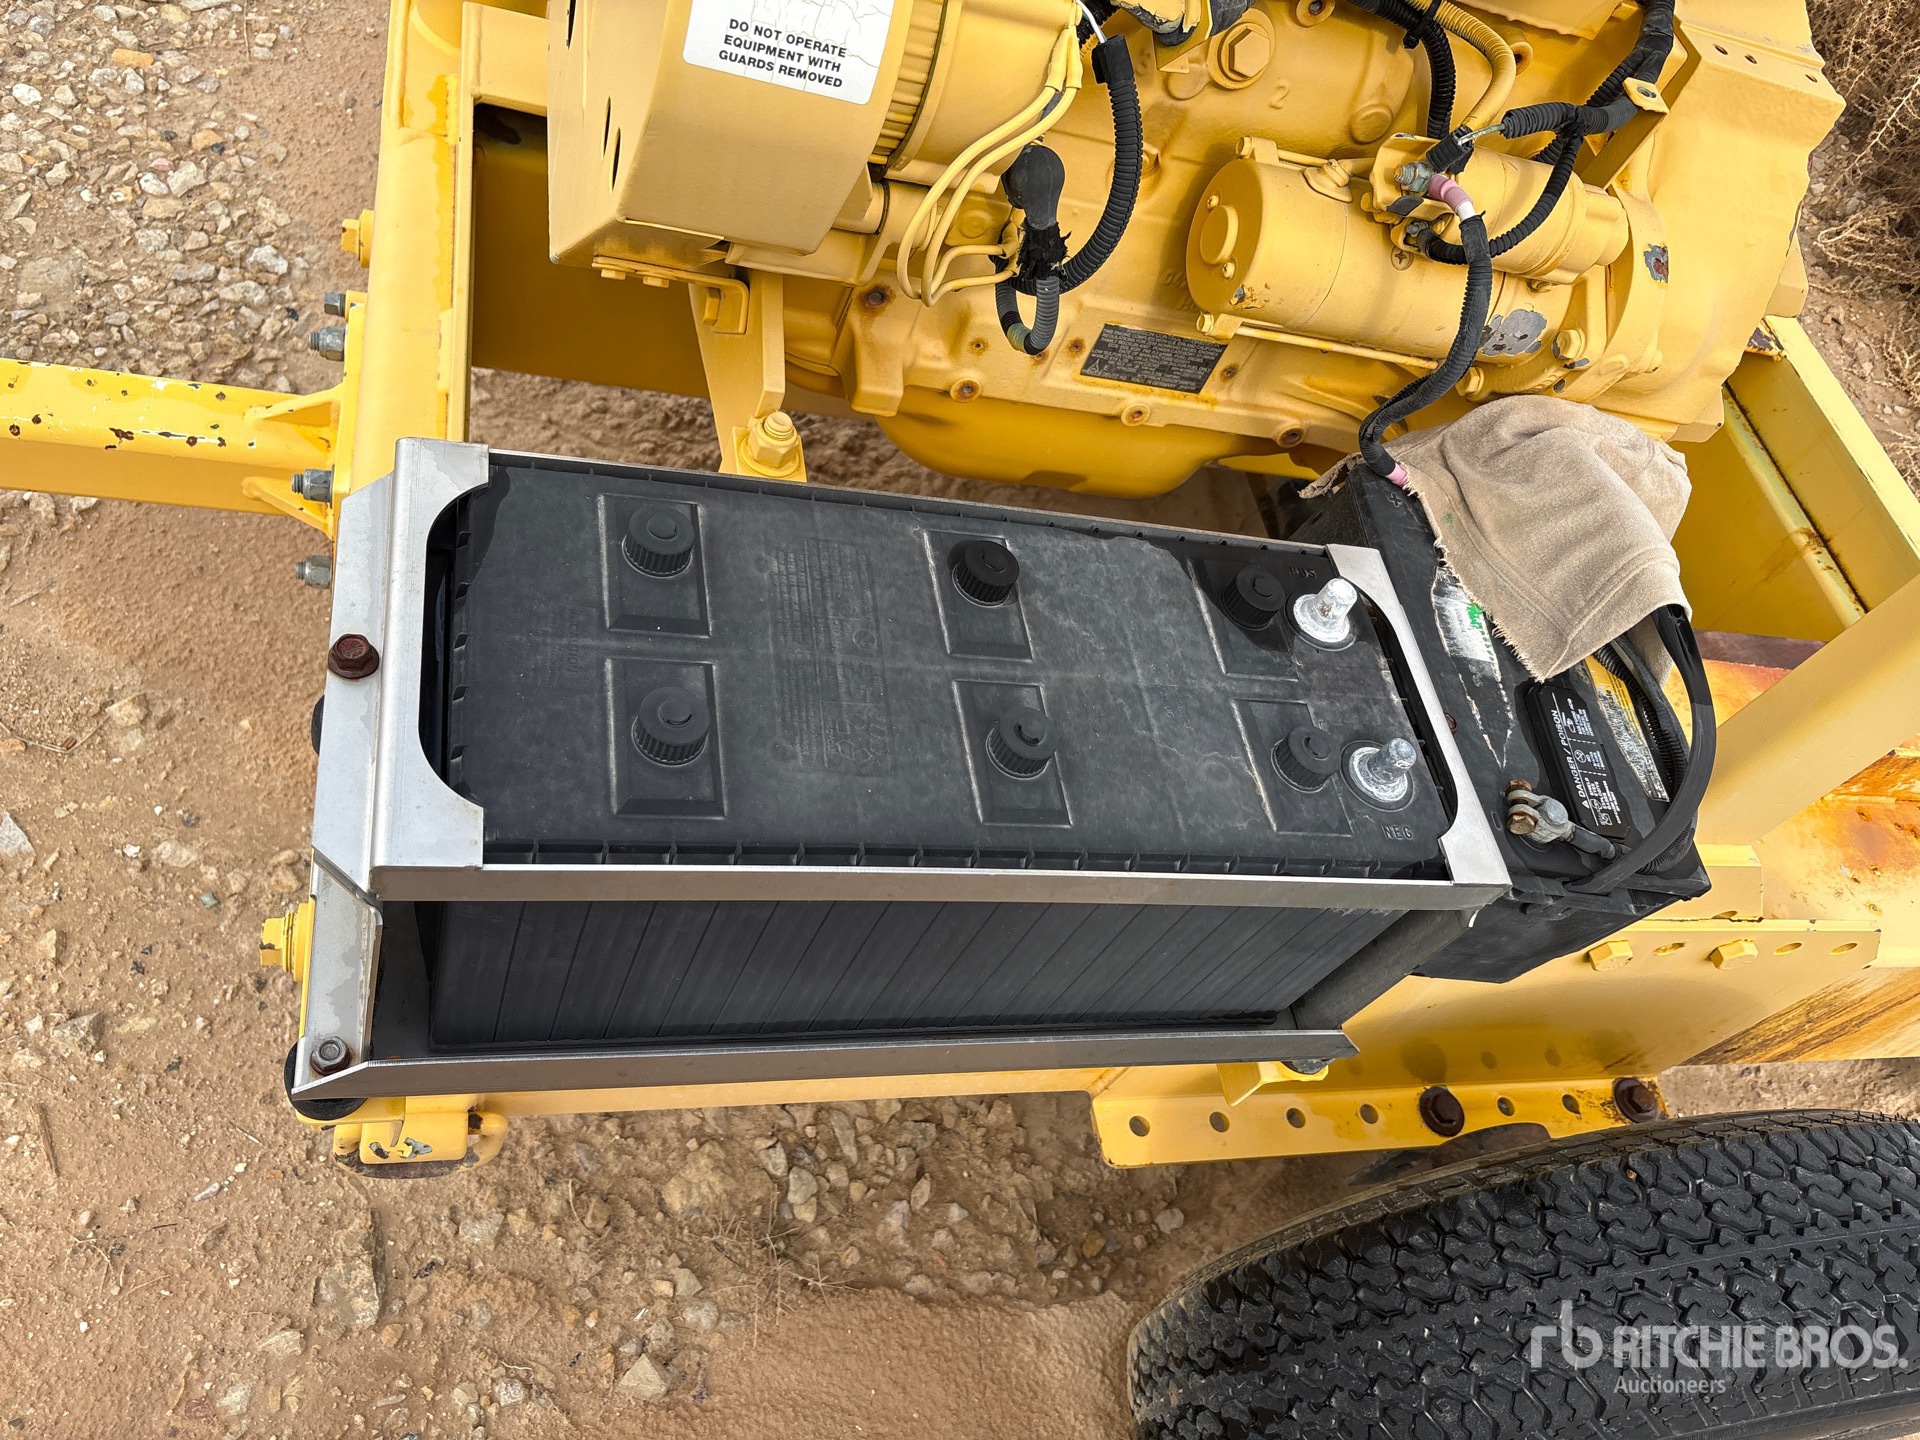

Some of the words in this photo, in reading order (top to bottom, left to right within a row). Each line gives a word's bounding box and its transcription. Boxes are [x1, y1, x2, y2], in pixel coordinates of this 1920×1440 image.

[723, 34, 804, 63] EQUIPMENT
[808, 55, 841, 72] WITH
[729, 18, 749, 32] DO
[753, 25, 782, 41] NOT
[786, 34, 847, 58] OPERATE
[719, 51, 775, 72] GUARDS
[778, 64, 843, 88] REMOVED
[1551, 710, 1568, 746] POISON
[1566, 757, 1584, 797] DANGER
[1383, 825, 1413, 840] NEG
